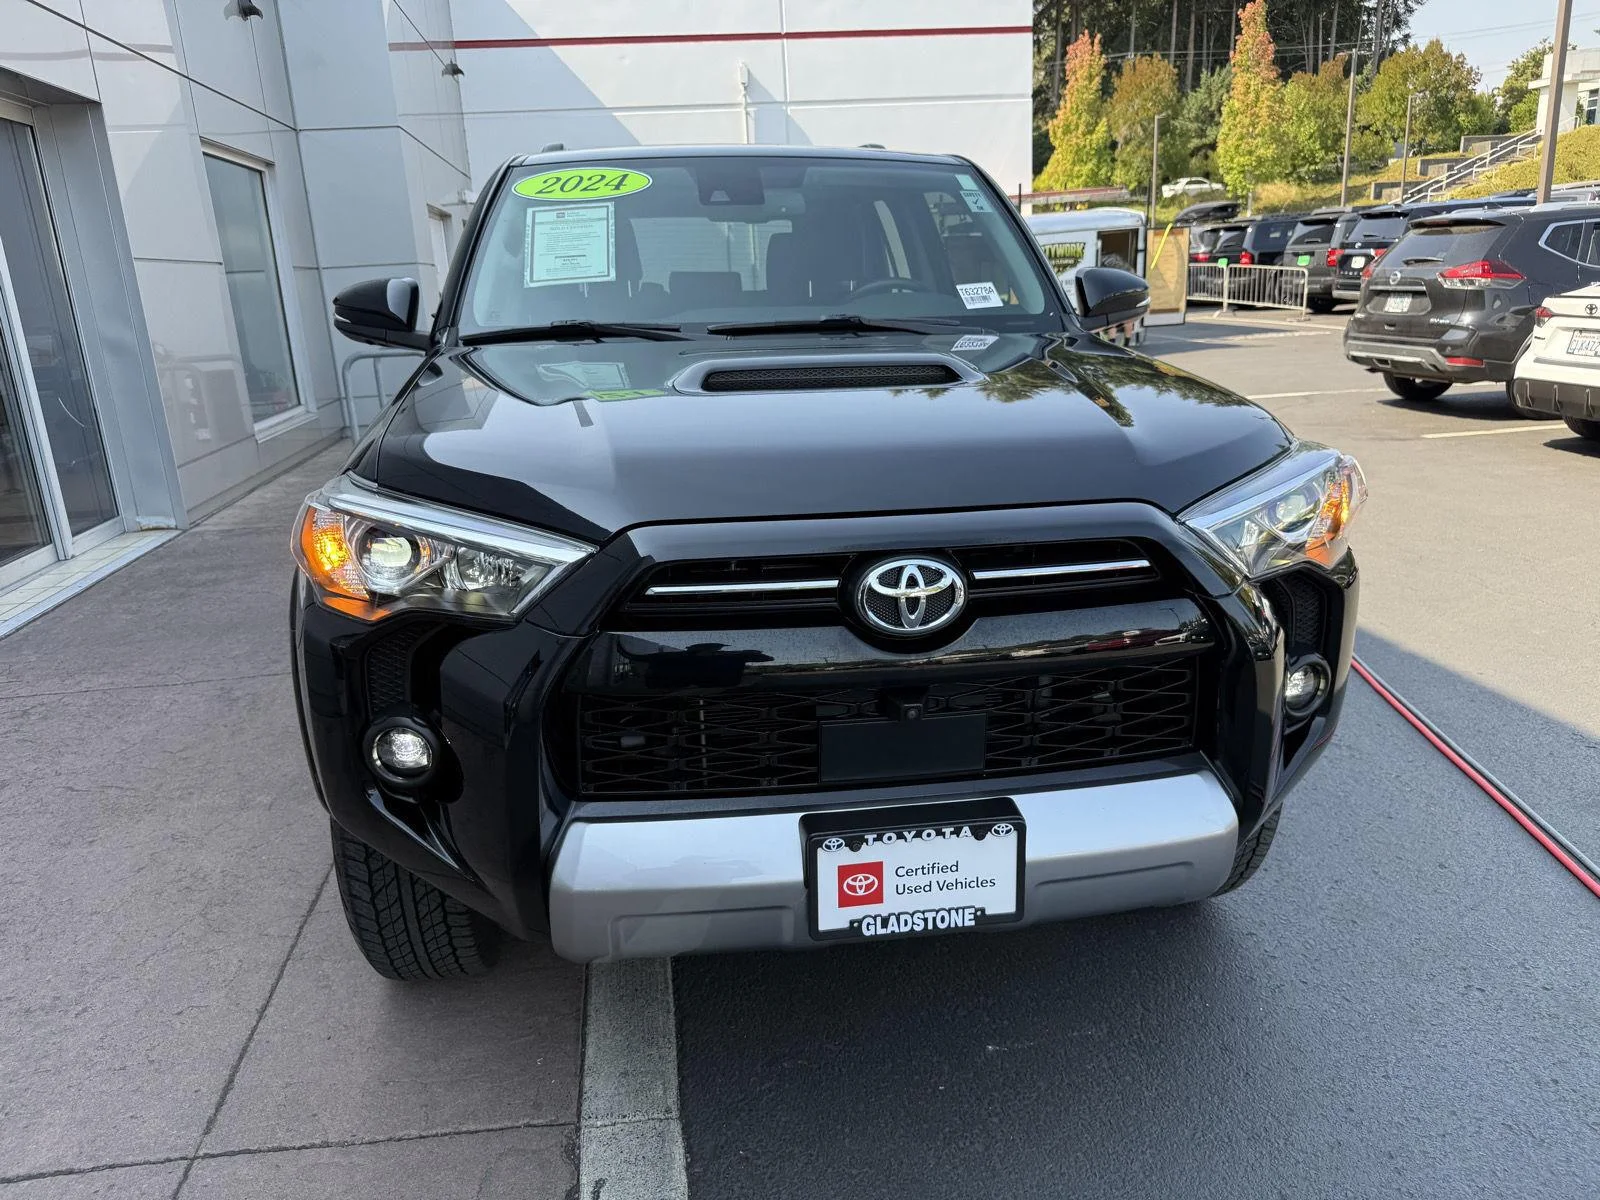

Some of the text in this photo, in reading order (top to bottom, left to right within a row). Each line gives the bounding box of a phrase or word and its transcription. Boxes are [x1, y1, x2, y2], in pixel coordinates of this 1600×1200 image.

[535, 173, 630, 195] 2024
[959, 286, 995, 296] T63278A
[865, 826, 973, 846] TOYOTA
[895, 860, 959, 878] Certified
[895, 876, 996, 895] Used Vehicles
[861, 906, 976, 936] GLADSTONE
